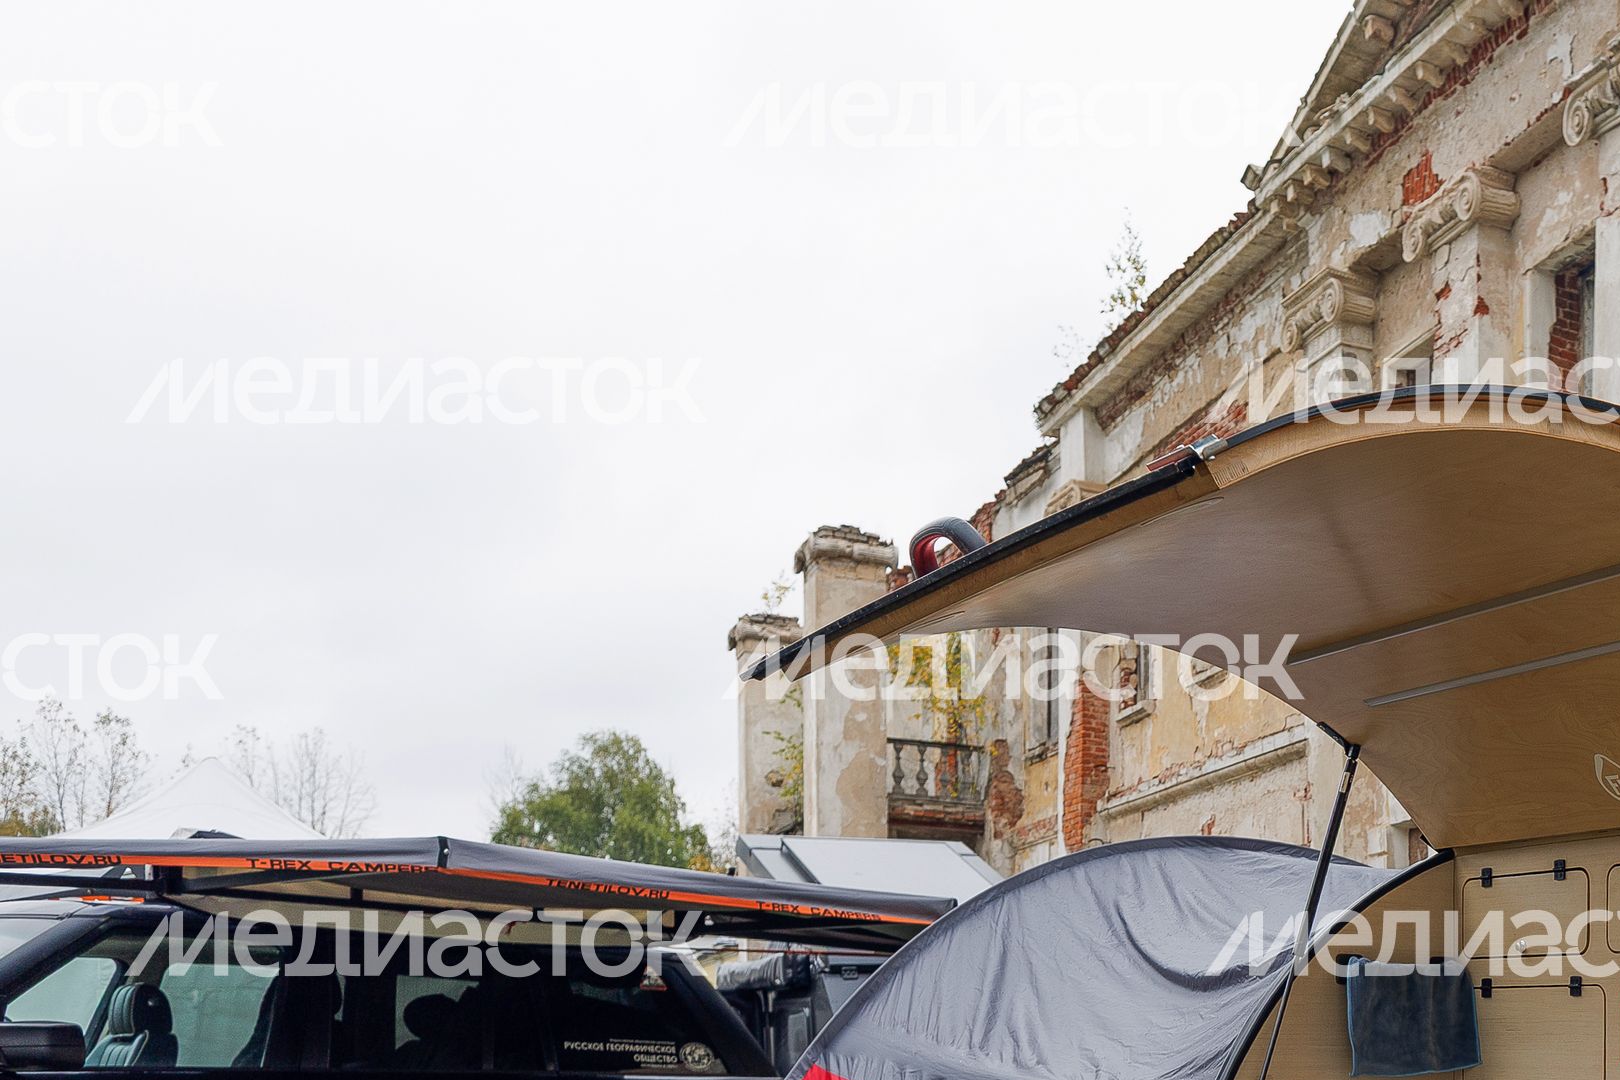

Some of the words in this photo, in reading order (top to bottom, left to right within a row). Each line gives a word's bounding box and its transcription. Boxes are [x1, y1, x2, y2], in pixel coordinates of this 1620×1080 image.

[0, 853, 122, 866] ETILOV.RU
[246, 858, 312, 870] T-REX
[544, 878, 670, 900] TENETILOV.RU
[756, 901, 800, 913] T-REX
[563, 1041, 604, 1051] РУССКОЕ
[605, 1042, 677, 1054] ГЕОГРАФИЧЕСКОЕ
[633, 1054, 678, 1064] ОБЩЕСТВО
